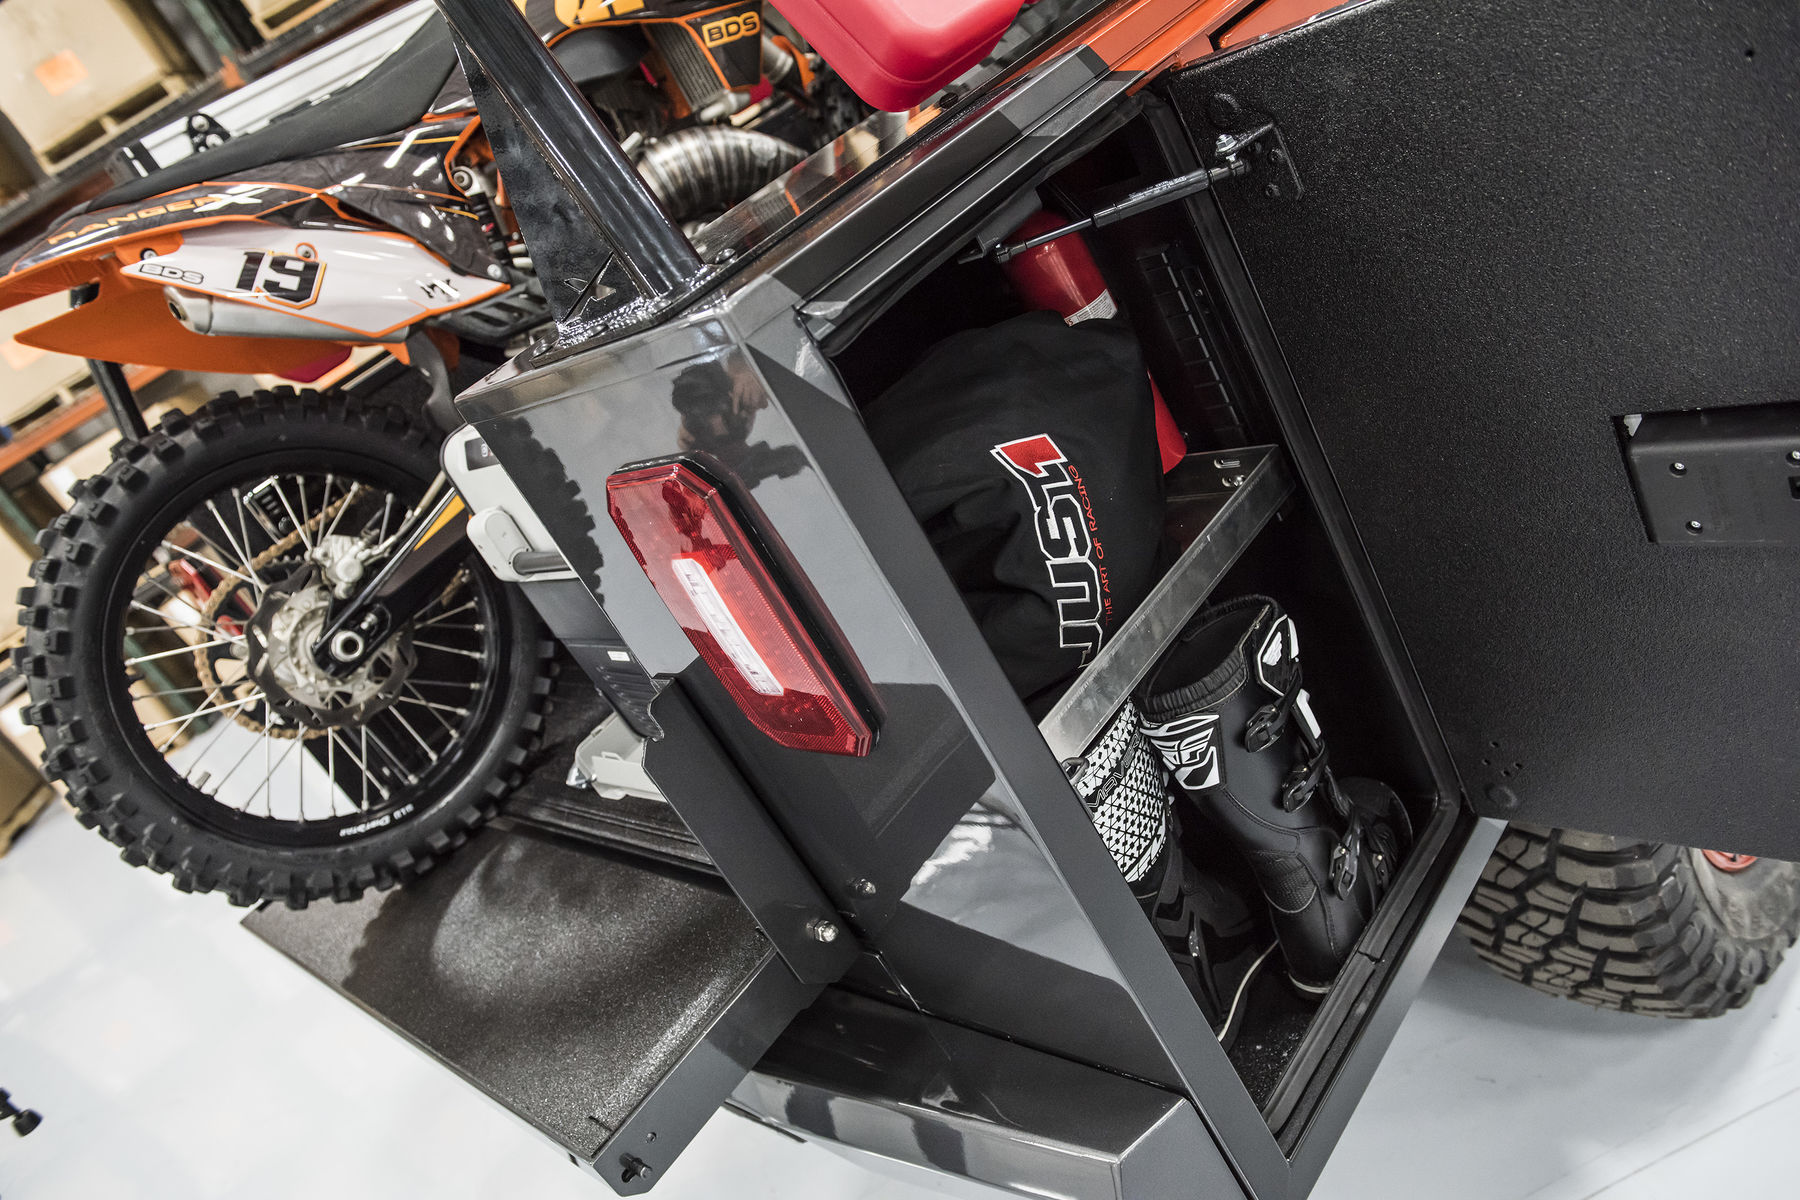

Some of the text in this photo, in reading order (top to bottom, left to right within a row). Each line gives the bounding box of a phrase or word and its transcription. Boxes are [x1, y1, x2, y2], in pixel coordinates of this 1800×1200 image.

[706, 14, 758, 43] BDS
[139, 263, 205, 285] BDS
[236, 251, 320, 303] 19
[1068, 464, 1113, 626] THE ART OF RACING
